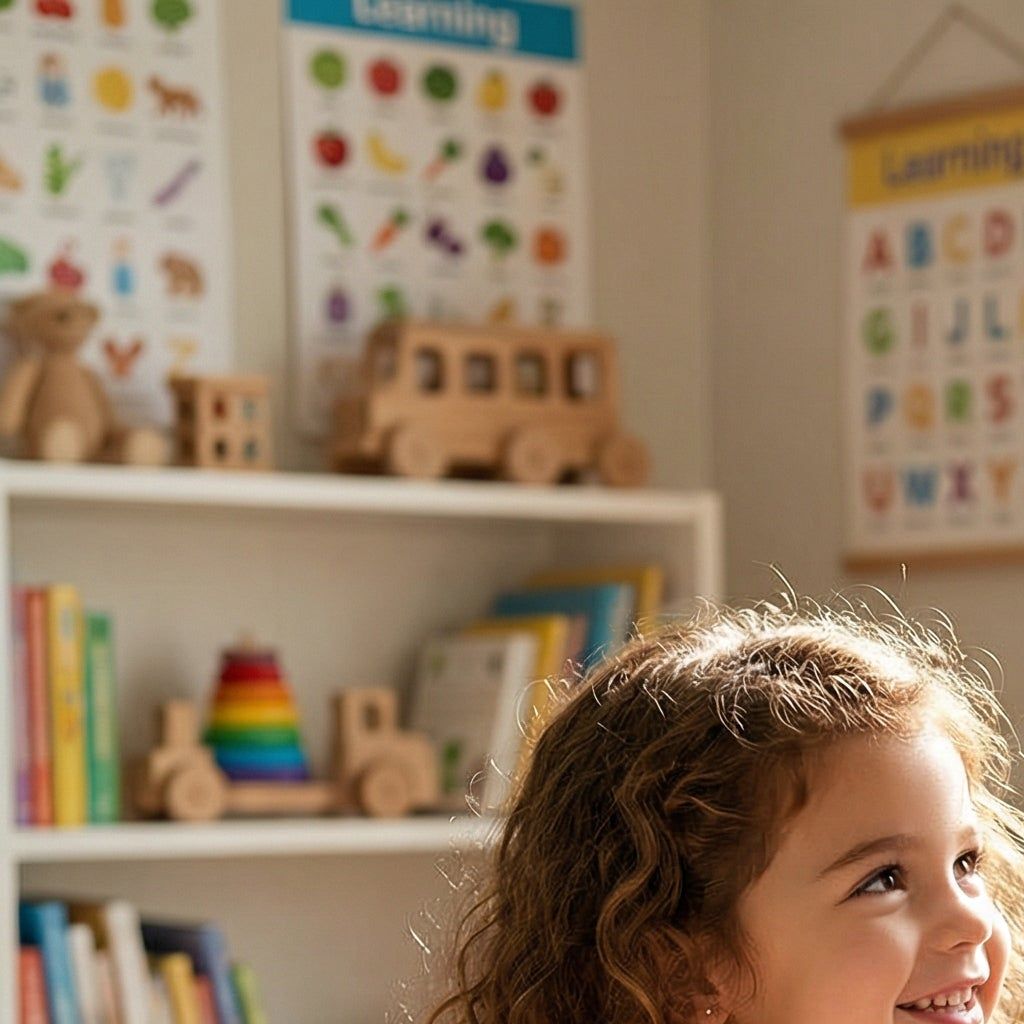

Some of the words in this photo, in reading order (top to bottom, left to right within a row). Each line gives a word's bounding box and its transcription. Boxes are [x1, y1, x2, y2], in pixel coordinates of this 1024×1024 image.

[352, 0, 520, 50] Learning
[863, 228, 893, 272] A
[904, 220, 934, 271] B
[942, 211, 973, 266] C
[982, 209, 1017, 258] D
